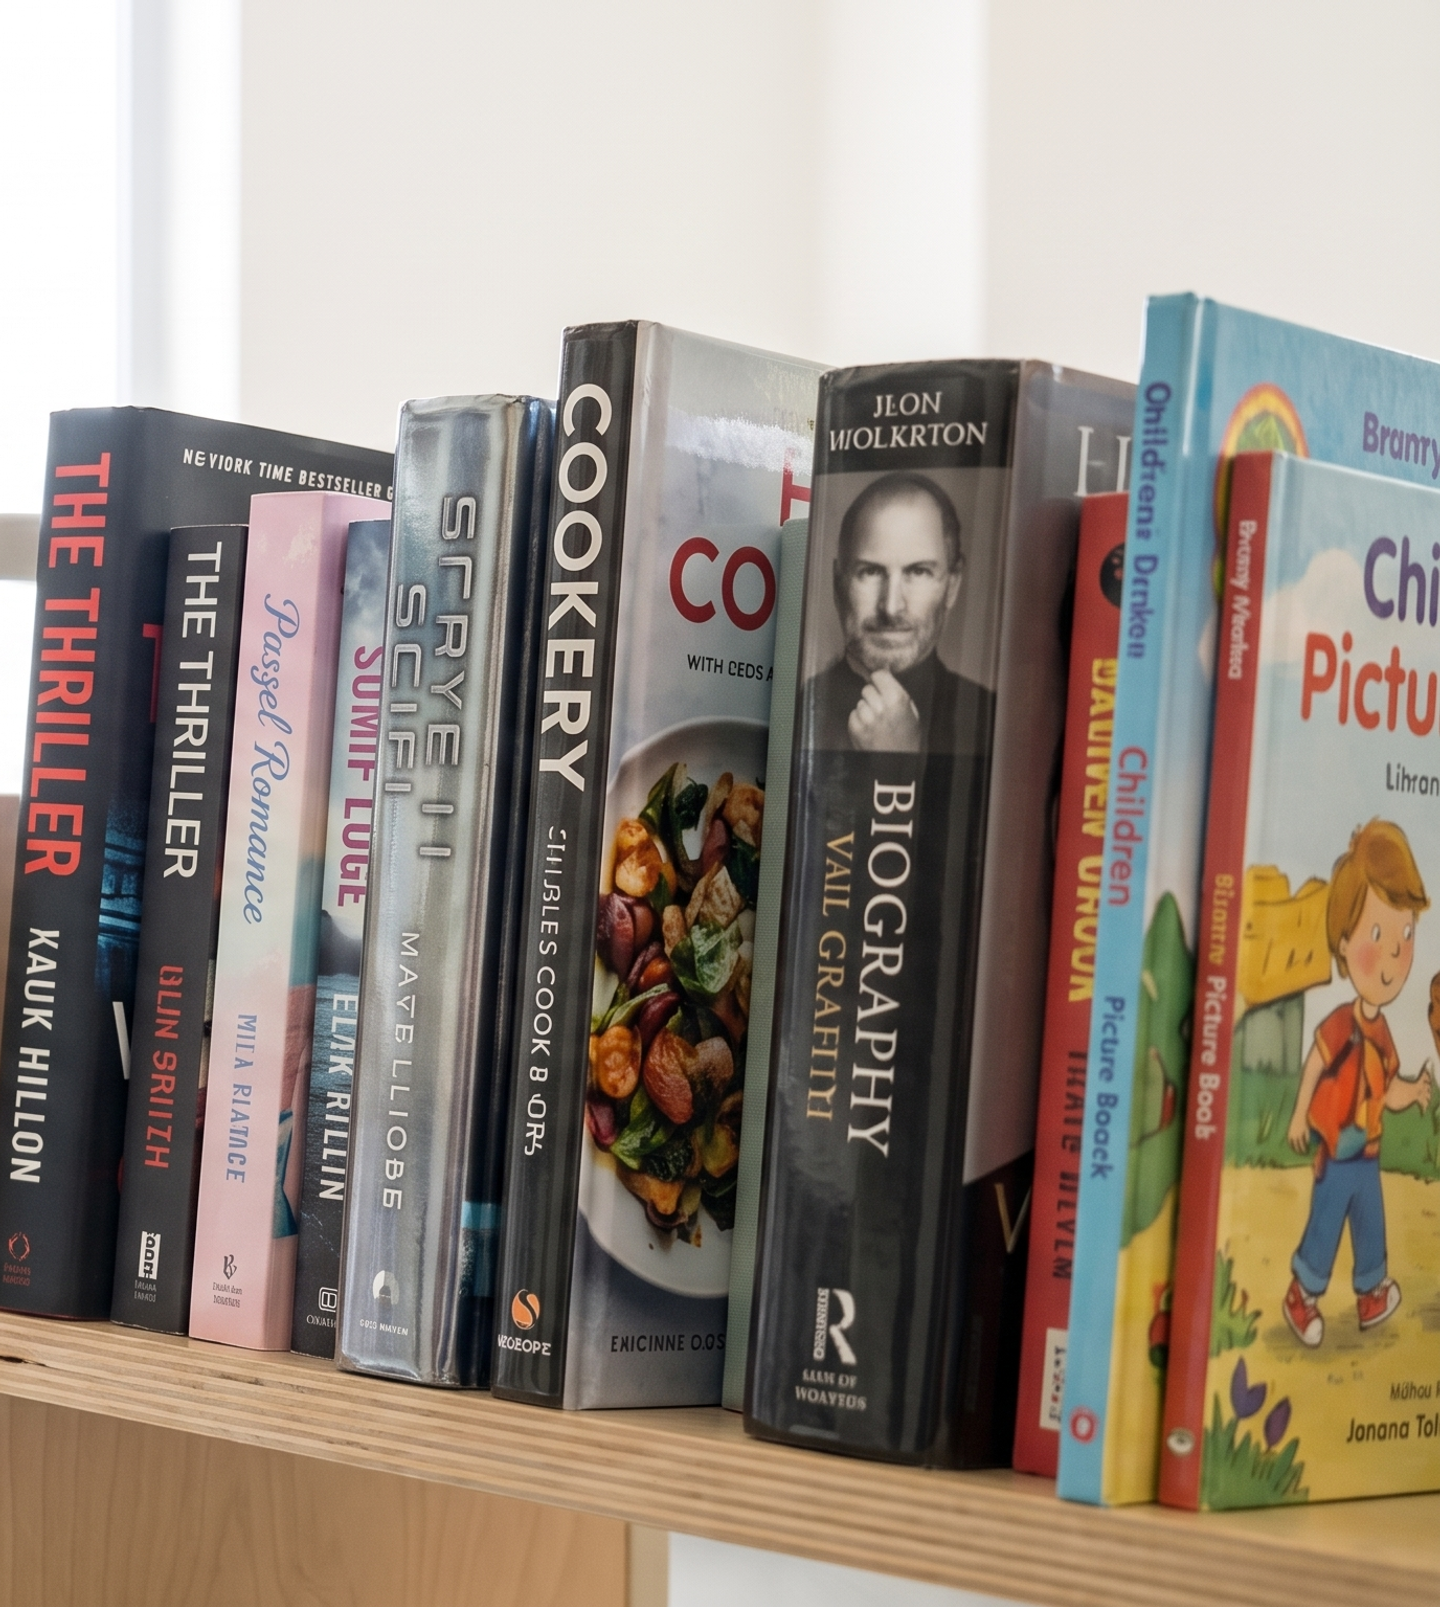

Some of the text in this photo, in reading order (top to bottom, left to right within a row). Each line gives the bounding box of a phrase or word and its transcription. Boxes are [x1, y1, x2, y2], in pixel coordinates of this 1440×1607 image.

[259, 461, 294, 483] TIME
[298, 469, 381, 498] BESTSELLER
[538, 382, 613, 793] COOKERY
[24, 452, 111, 877] THE THRILLER
[163, 541, 222, 879] THE THRILLER
[687, 653, 723, 675] WITH
[1300, 631, 1440, 737] Pictu
[242, 740, 291, 924] Romance
[822, 832, 855, 917] VAIL
[1107, 746, 1148, 907] Children
[530, 966, 556, 1057] COOK
[847, 779, 916, 1159] BIOGRAPHY
[1098, 995, 1125, 1084] Picture
[10, 1047, 50, 1183] HILLON
[319, 1091, 351, 1201] RILLIN
[1416, 1412, 1440, 1438] Tol
